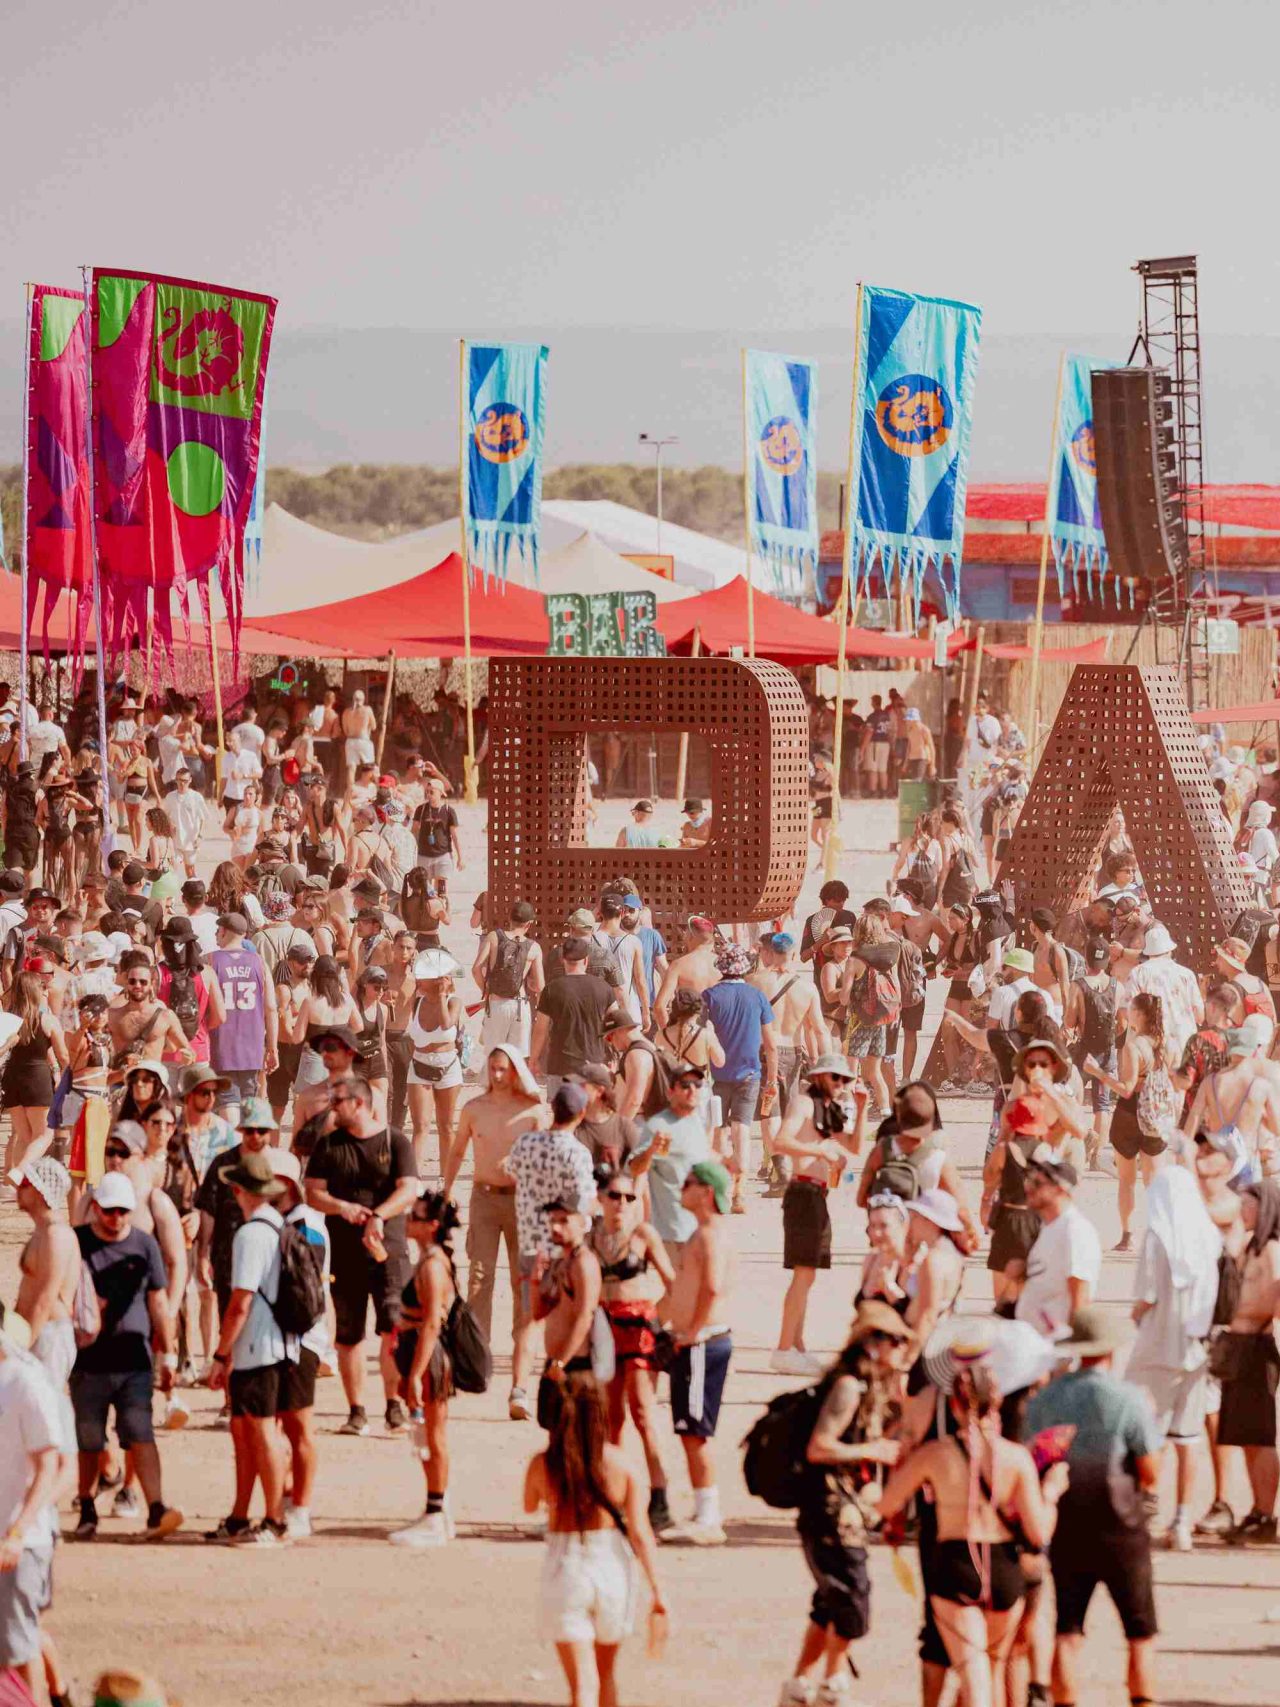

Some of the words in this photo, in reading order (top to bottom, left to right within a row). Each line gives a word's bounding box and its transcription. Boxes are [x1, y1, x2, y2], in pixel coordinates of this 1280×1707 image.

[544, 590, 667, 657] BAR
[225, 965, 251, 979] NASH
[222, 981, 257, 1010] 13
